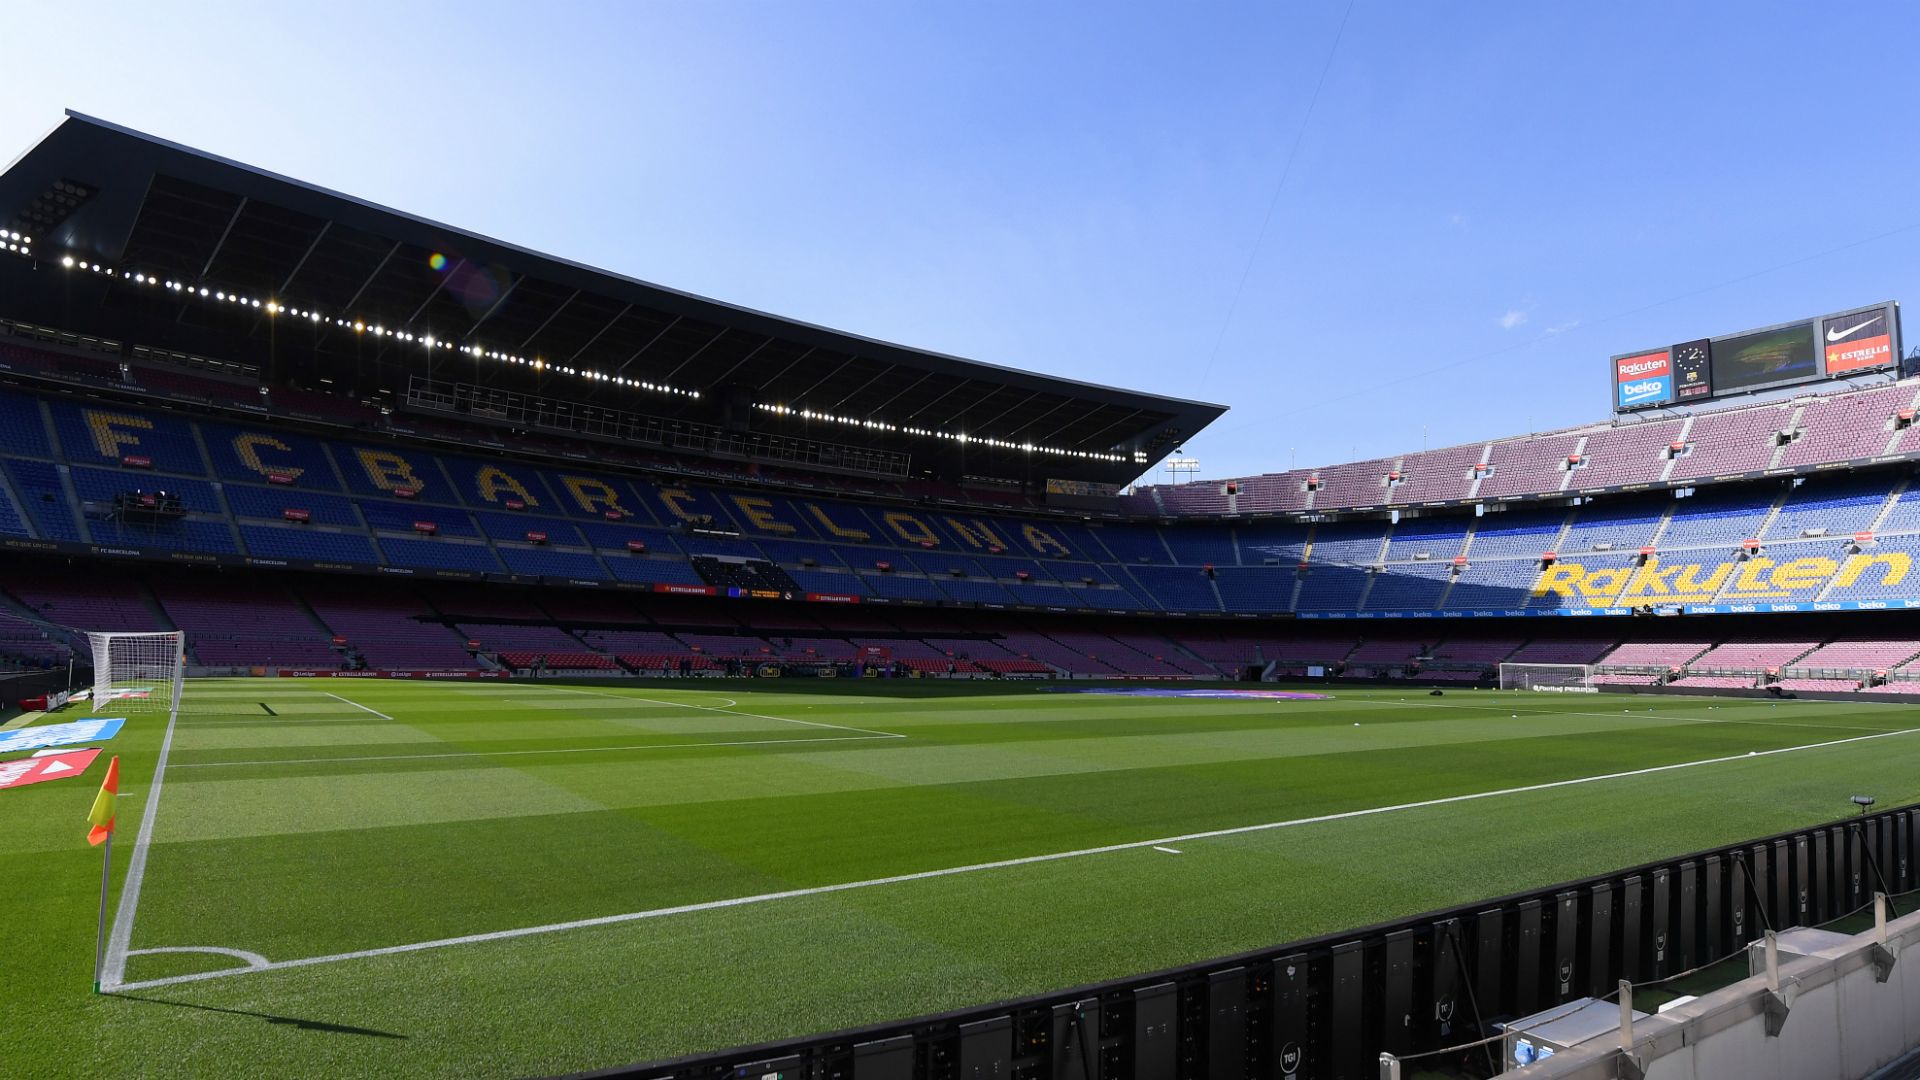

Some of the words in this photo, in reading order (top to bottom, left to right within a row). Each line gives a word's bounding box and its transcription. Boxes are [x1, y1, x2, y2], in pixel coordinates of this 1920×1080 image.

[1841, 344, 1889, 360] ESTRELLA
[1619, 359, 1667, 375] Rakuten
[1624, 381, 1662, 395] beko
[1534, 552, 1912, 598] Rakuten
[1772, 603, 1797, 611] beko
[1814, 602, 1840, 610] beko
[1858, 600, 1887, 608] beko
[1284, 1053, 1296, 1063] TGI
